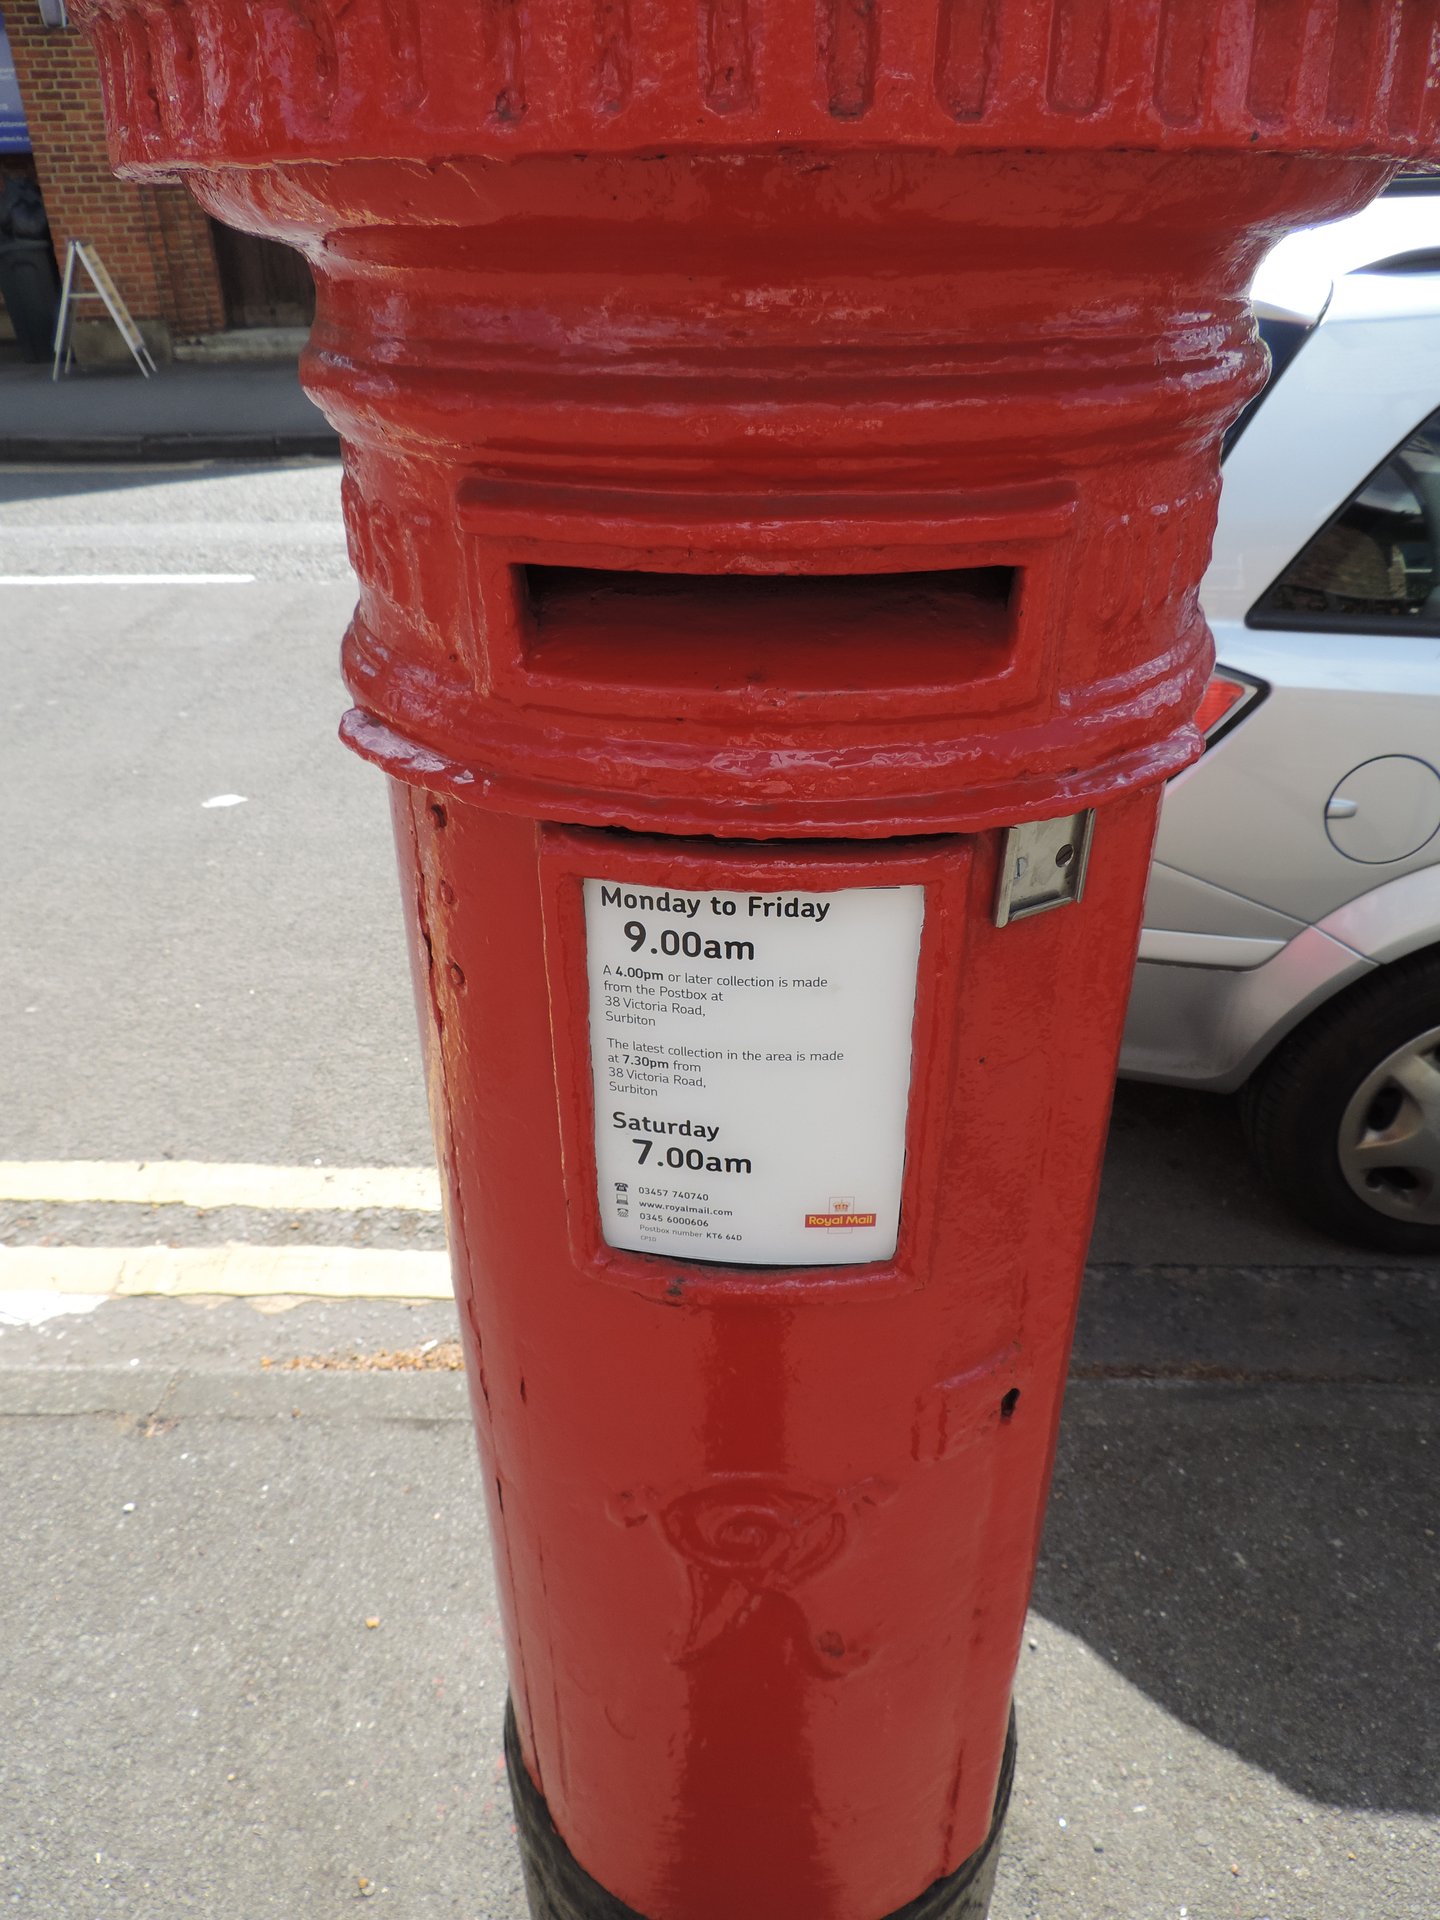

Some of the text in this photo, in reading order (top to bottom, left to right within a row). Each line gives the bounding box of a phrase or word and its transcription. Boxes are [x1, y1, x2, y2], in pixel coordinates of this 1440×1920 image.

[601, 886, 831, 923] Monday to Friday
[623, 921, 755, 961] 9.00am
[602, 965, 828, 988] A 4.00pm or later collection is made
[603, 980, 724, 1002] from the Postbox at
[605, 996, 706, 1017] 38 Victoria Road,
[605, 1011, 656, 1027] Surbiton
[606, 1038, 844, 1062] The latest collection in the area is made
[607, 1053, 702, 1073] at 7.30pm from
[608, 1067, 706, 1089] 38 Victoria Road,
[609, 1081, 658, 1097] Surbiton
[612, 1112, 720, 1143] Saturday
[631, 1138, 752, 1174] 7.00am
[638, 1187, 709, 1202] 03457 740740
[639, 1202, 733, 1216] www.royalmail.com
[639, 1213, 709, 1227] 0345 6000606
[808, 1216, 873, 1227] Royal Mail
[639, 1225, 670, 1234] Postbox
[672, 1230, 702, 1238] number
